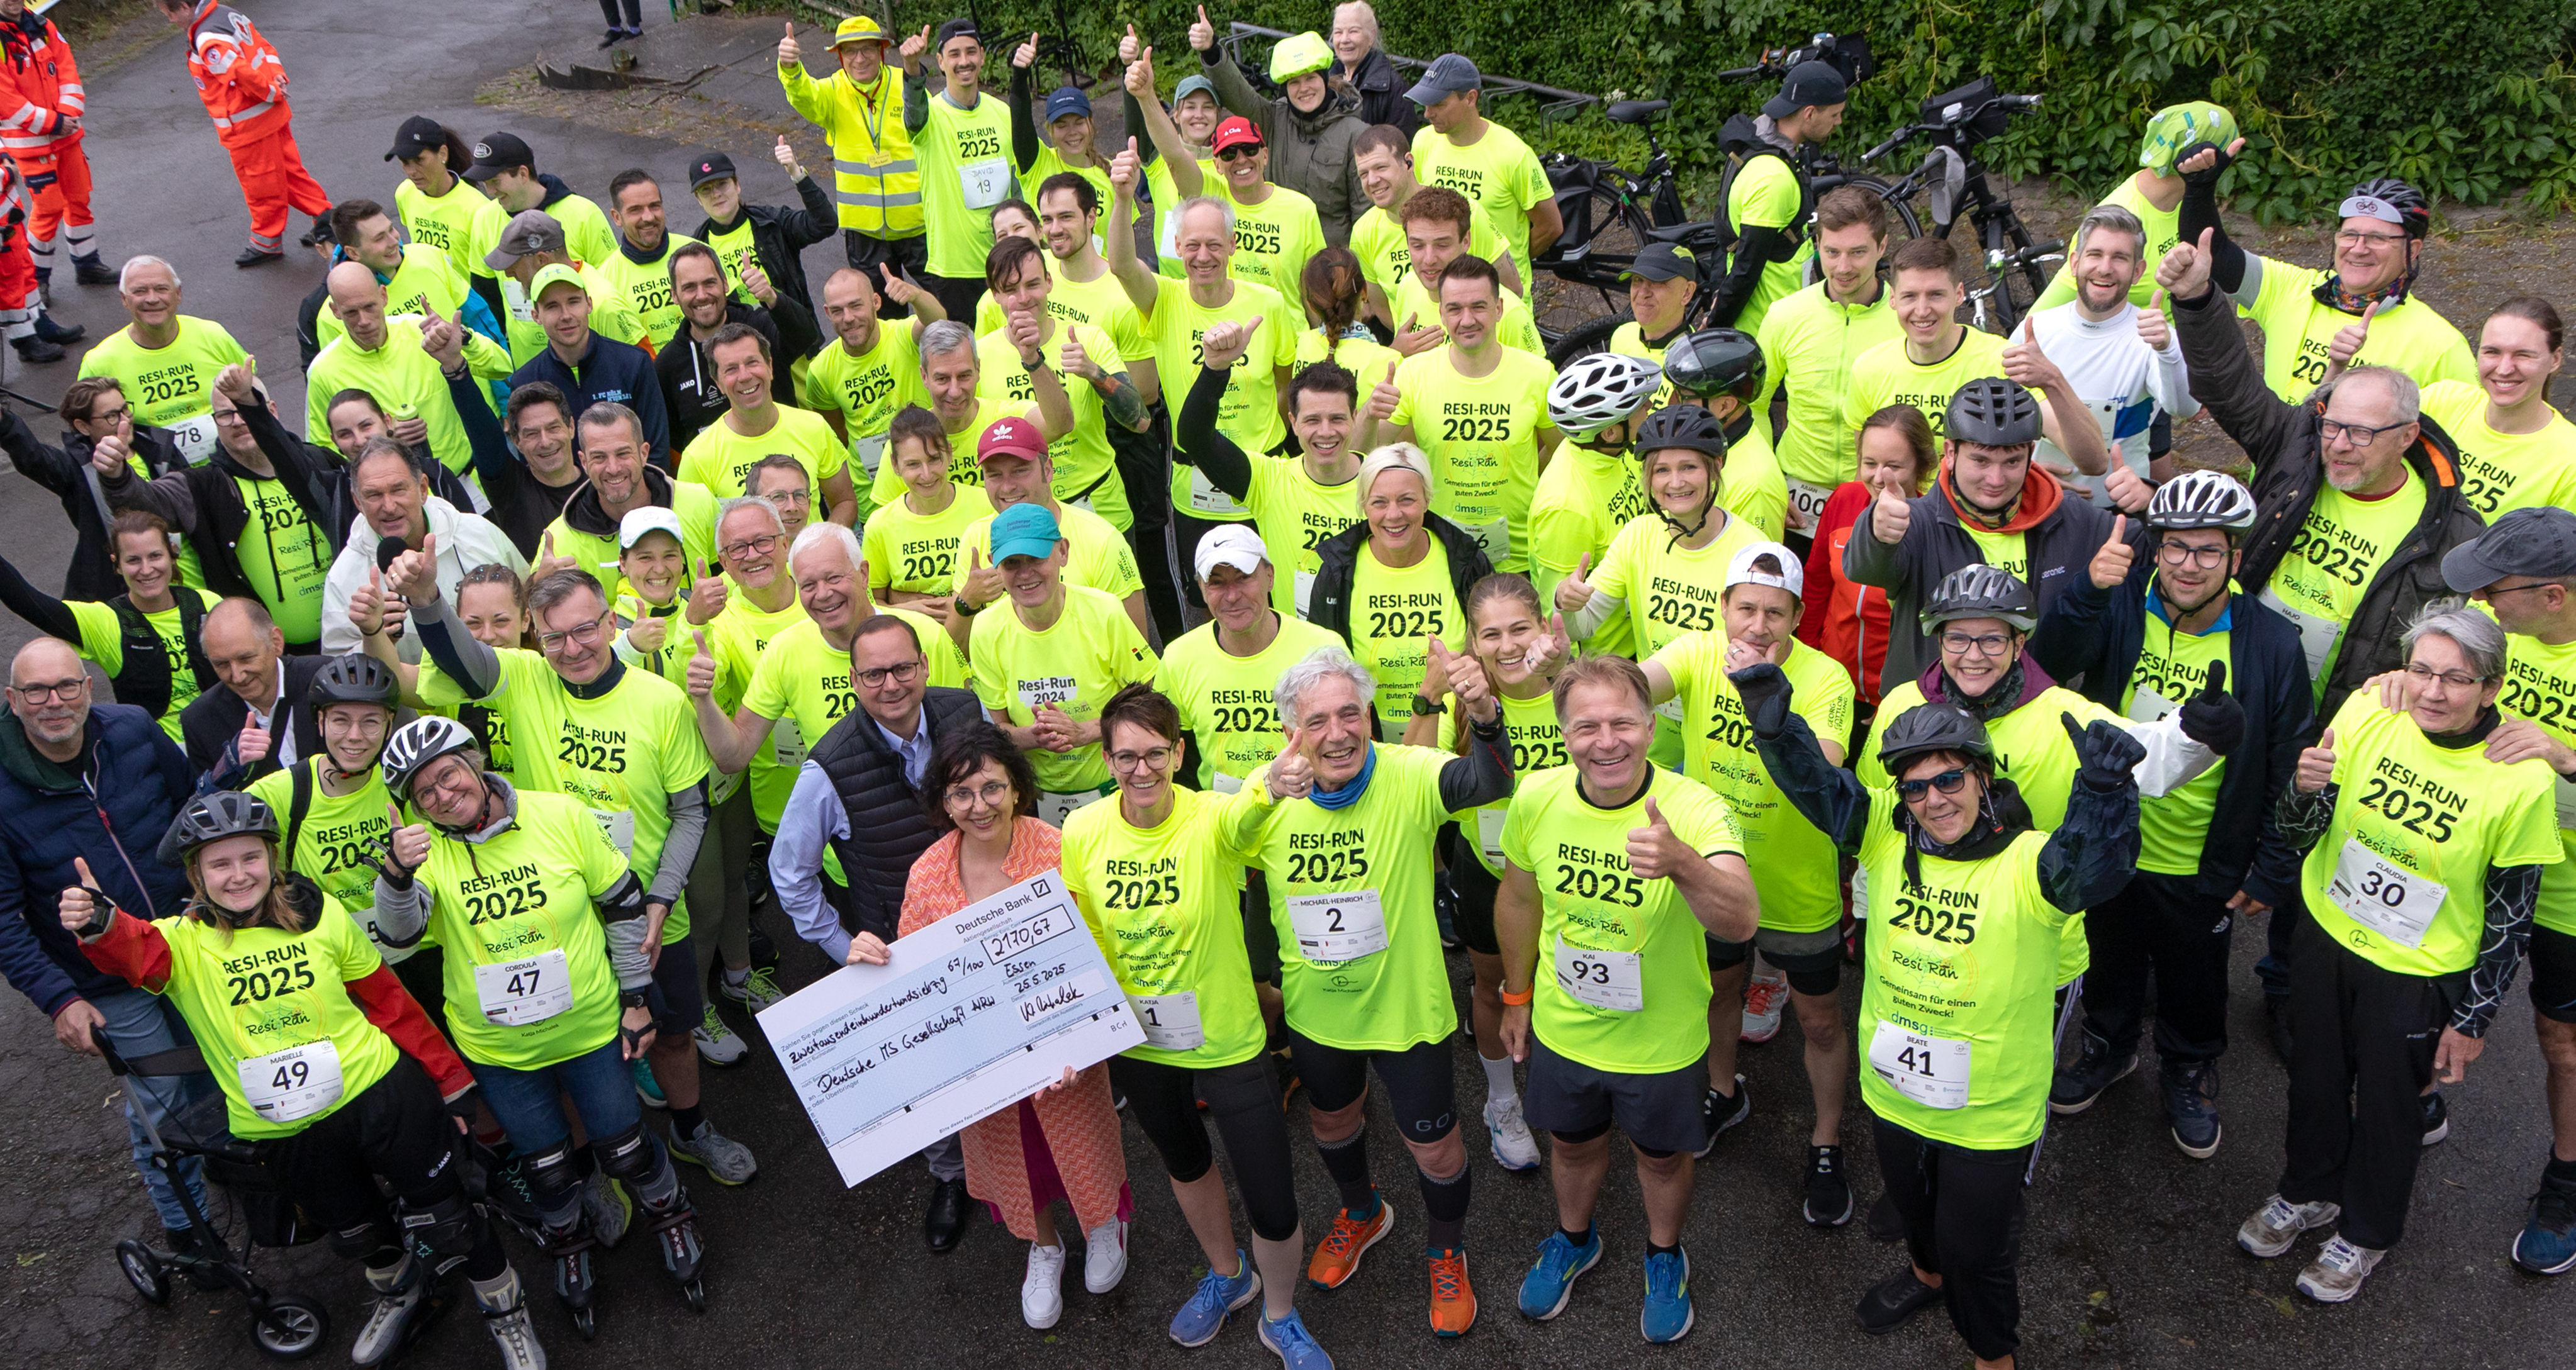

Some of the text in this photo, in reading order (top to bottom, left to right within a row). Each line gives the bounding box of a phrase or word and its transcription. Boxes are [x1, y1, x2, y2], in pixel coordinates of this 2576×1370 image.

[958, 126, 995, 140] RESI-RUN
[960, 138, 1000, 159] 2025
[973, 166, 994, 175] DAVID
[1436, 166, 1482, 180] RESI-RUN
[977, 180, 992, 194] 19
[415, 217, 449, 233] RESI-RUN
[415, 229, 450, 250] 2025
[138, 362, 194, 386] RESI-RUN
[680, 379, 695, 391] JAKO
[142, 377, 200, 406] 2025
[849, 376, 895, 410] 2025
[1443, 403, 1511, 416] RESI-RUN
[177, 427, 202, 449] 78
[992, 433, 1012, 441] adidas
[1443, 418, 1511, 442] 2025
[1050, 448, 1070, 458] Zweck!
[1063, 438, 1078, 447] einen
[1450, 457, 1474, 468] Resi
[1445, 479, 1479, 488] Gemeinsam
[1480, 480, 1490, 488] für
[1455, 489, 1498, 498] guten Zweck!
[1608, 471, 1636, 515] RESI-RUN
[1801, 484, 1818, 493] JULIAN
[1454, 503, 1484, 516] dmsg
[1788, 489, 1826, 516] 100
[2305, 511, 2378, 559] RESI-RUN
[2291, 528, 2371, 586] 2025
[1369, 593, 1443, 608] RESI-RUN
[1652, 577, 1718, 603] RESI-RUN
[1369, 610, 1444, 638] 2025
[1649, 594, 1715, 632] 2025
[2282, 608, 2301, 620] HAJO
[1017, 677, 1076, 692] Resi-Run
[1034, 691, 1066, 704] 2024
[1386, 692, 1403, 701] guten
[563, 718, 626, 745] RESI-RUN
[558, 736, 626, 774] 2025
[1226, 750, 1252, 761] Resi
[2375, 755, 2468, 813] RESI-RUN
[1741, 798, 1778, 810] für einen
[2359, 777, 2458, 845] 2025
[317, 815, 389, 844] RESI-RUN
[1290, 828, 1365, 849] RESI-RUN
[2356, 828, 2385, 852] Resi
[1286, 848, 1368, 884] 2025
[1558, 842, 1629, 871] RESI-RU
[460, 862, 538, 896] RESI-RUN
[2375, 862, 2408, 884] CLAUDIA
[1106, 875, 1180, 910] 2025
[1555, 864, 1645, 908] 2025
[1901, 879, 1979, 910] RESI-RUN
[2361, 870, 2405, 907] 30
[465, 880, 547, 926] 2025
[1300, 895, 1363, 908] MICHAEL-HEINRICH
[955, 894, 1033, 935] Deutsche Bank
[1325, 908, 1345, 932] 2
[1567, 912, 1596, 929] Resi
[1888, 898, 1976, 945] 2025
[963, 918, 1012, 944] Aktiengesellschaft
[992, 918, 1050, 956] 2170,67
[1117, 928, 1145, 940] Resi
[222, 942, 306, 974] RESI-RUN
[484, 941, 514, 954] Resi
[1158, 950, 1170, 960] für
[1170, 948, 1192, 957] einen
[505, 961, 538, 972] CORDULA
[1004, 961, 1036, 978] Essen
[1150, 959, 1179, 971] Zweck!
[1571, 960, 1610, 984] 93
[1892, 950, 1925, 972] Resi
[227, 960, 316, 1007] 2025
[506, 969, 540, 998] 47
[1878, 976, 1976, 1008] Gemeinsam für einen
[1011, 994, 1026, 1003] Datum
[1892, 995, 1954, 1018] guten Zweck!
[781, 1002, 870, 1052] Zahlen Sie gegen diesen Scheck
[1026, 1015, 1051, 1030] Unterschrift
[1051, 1011, 1060, 1020] des
[1144, 1007, 1162, 1027] 1
[1891, 1010, 1929, 1037] dmsg
[245, 1022, 278, 1036] Resi
[535, 1024, 559, 1035] Michalek
[817, 996, 996, 1093] Deutsche MS Gesellschaft NRW
[1906, 1035, 1929, 1048] BEATE
[270, 1050, 304, 1065] MARIELLE
[1897, 1046, 1935, 1078] 41
[271, 1061, 309, 1091] 49
[812, 1079, 860, 1108] oder Überbringer
[439, 1151, 451, 1169] JAKO
